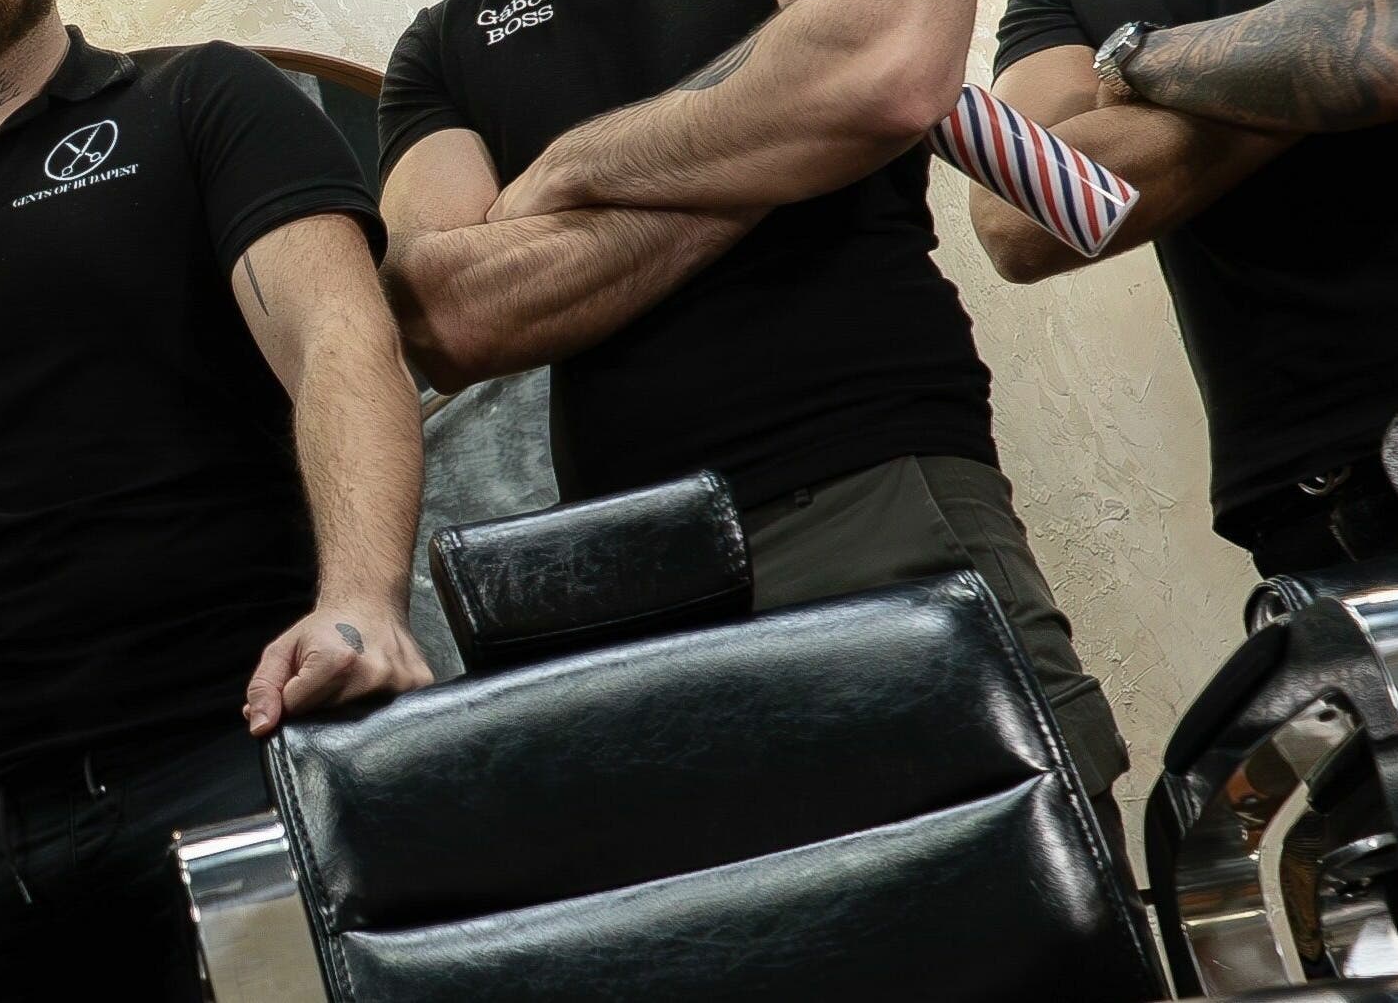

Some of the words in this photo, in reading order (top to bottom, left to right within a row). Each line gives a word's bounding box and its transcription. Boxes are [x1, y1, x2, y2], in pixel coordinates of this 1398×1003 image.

[485, 4, 554, 46] BOSS
[11, 187, 54, 209] GENTS
[53, 182, 73, 195] OF
[72, 162, 140, 190] BUDAPEST
